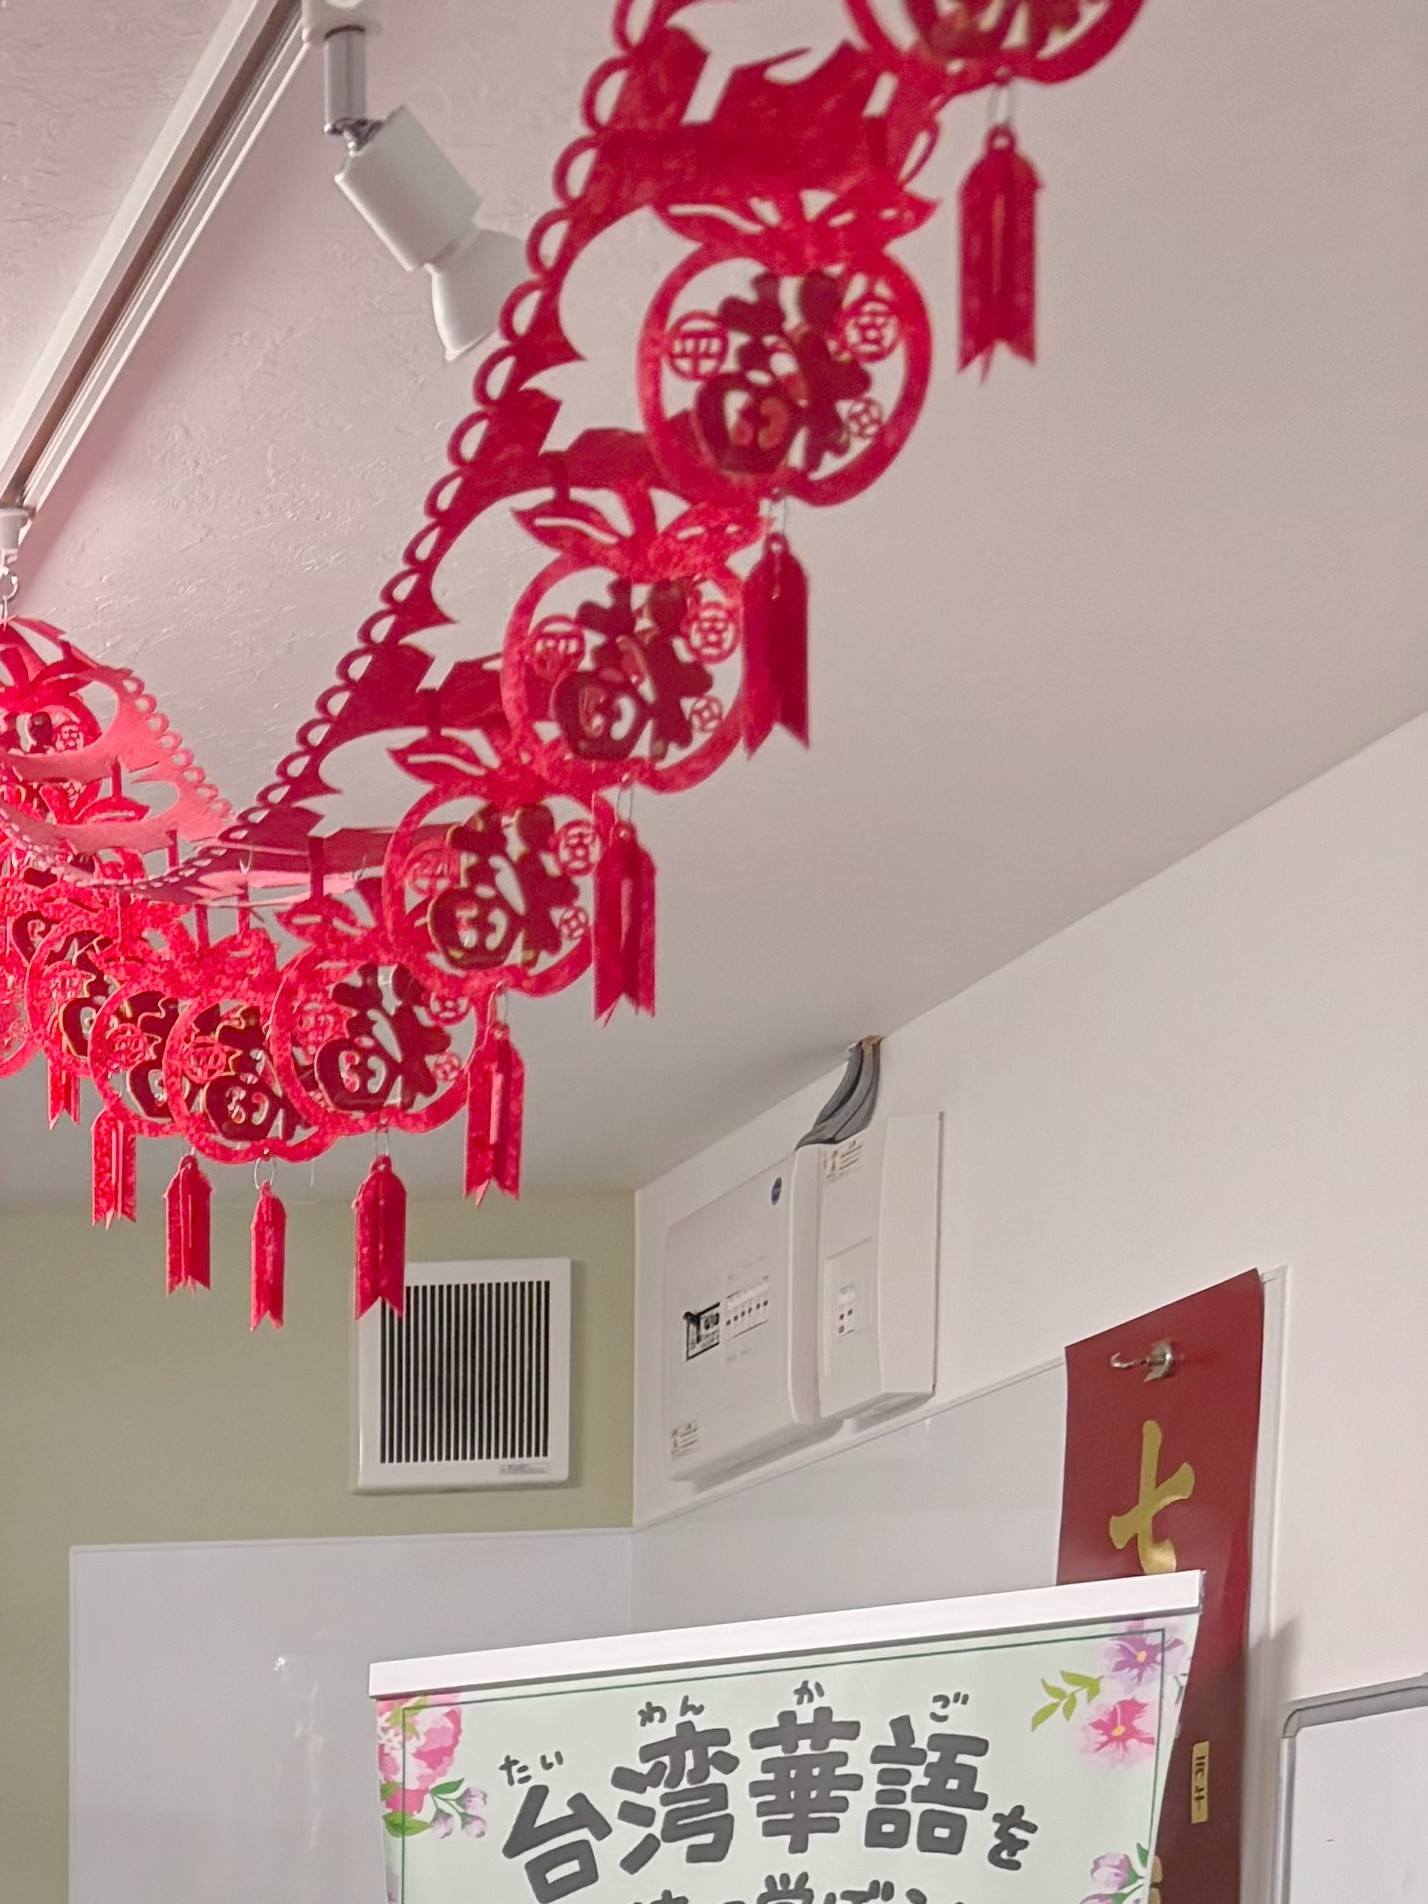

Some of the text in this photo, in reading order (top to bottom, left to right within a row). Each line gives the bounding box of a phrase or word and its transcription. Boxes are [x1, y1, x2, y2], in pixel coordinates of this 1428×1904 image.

[793, 1679, 826, 1706] か
[929, 1691, 970, 1723] ご
[636, 1695, 705, 1727] わん
[498, 1751, 564, 1787] たい
[502, 1706, 1039, 1904] 台湾華語を
